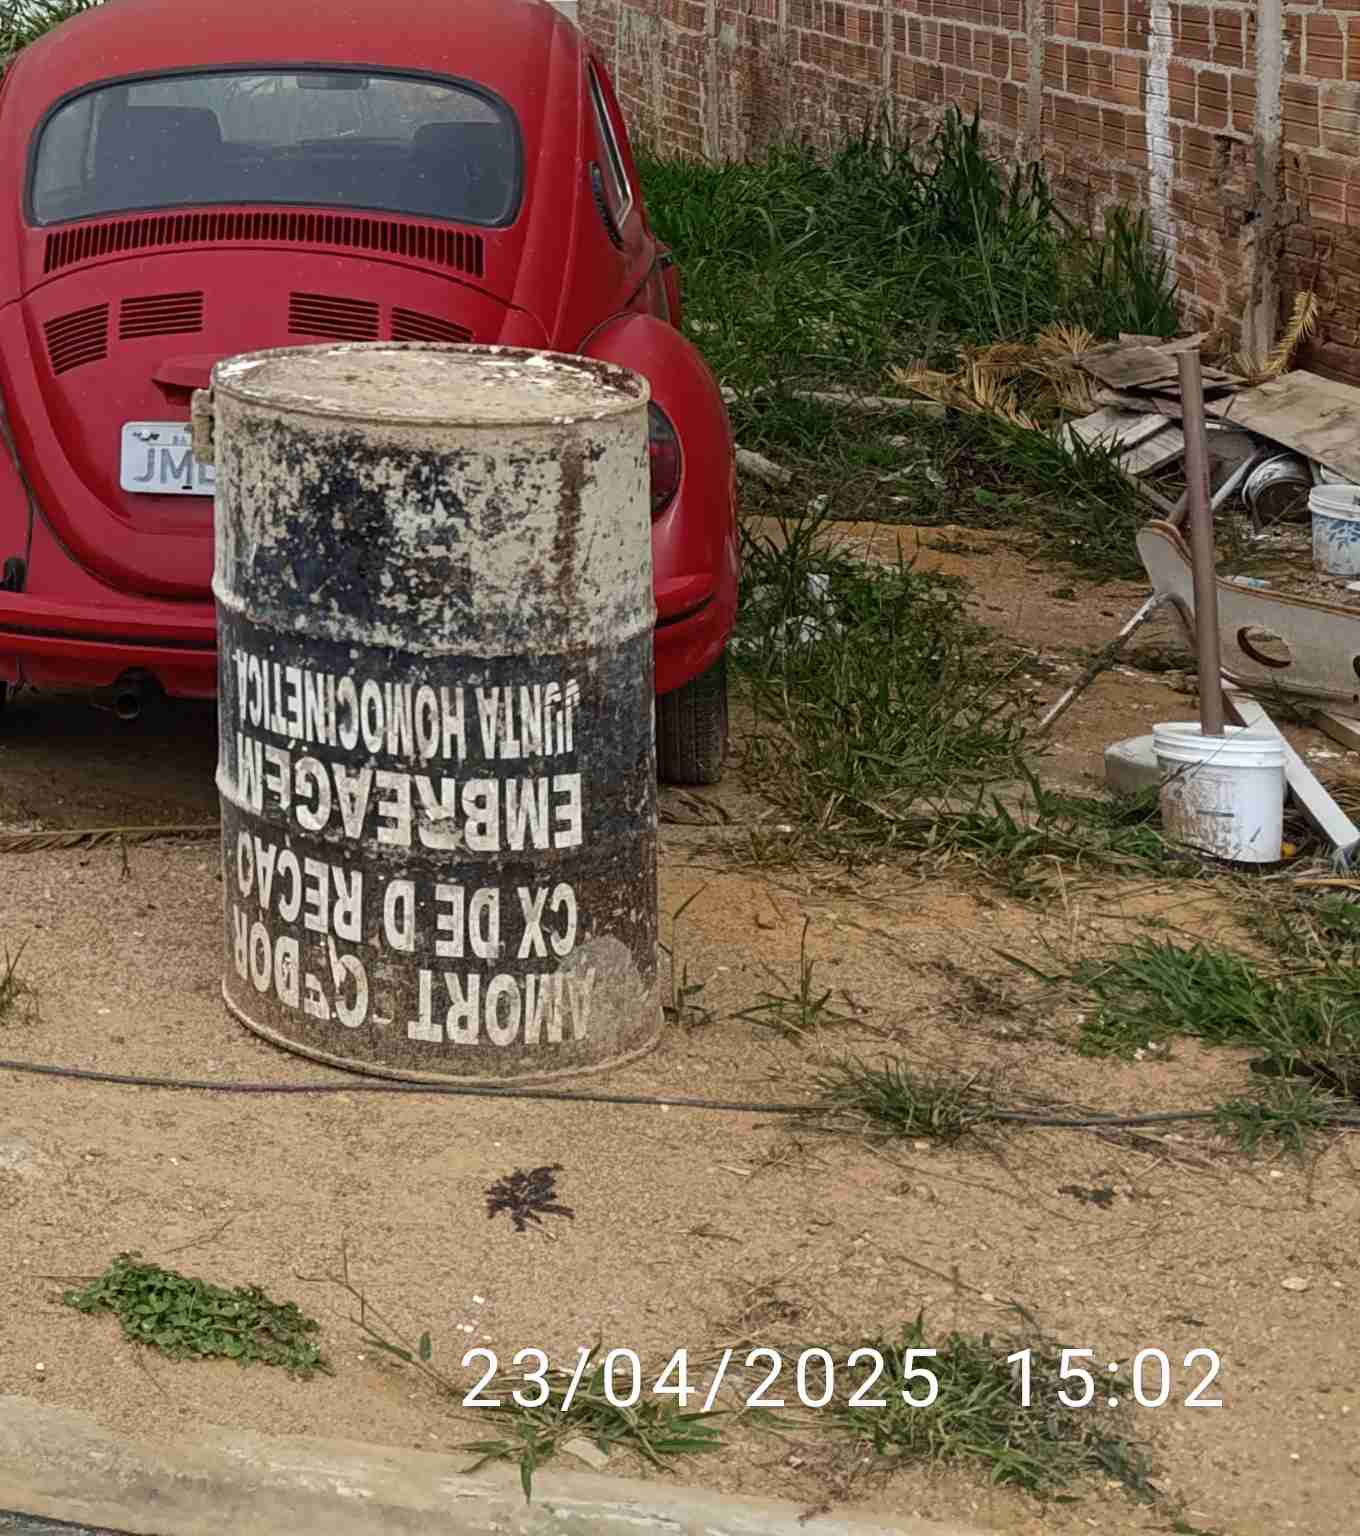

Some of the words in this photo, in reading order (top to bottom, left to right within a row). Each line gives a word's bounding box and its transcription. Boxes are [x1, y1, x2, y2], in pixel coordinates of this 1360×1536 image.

[476, 678, 580, 760] JUNTA
[236, 732, 582, 852] EMBREAGEM
[435, 883, 500, 959] DE
[518, 882, 578, 959] CX
